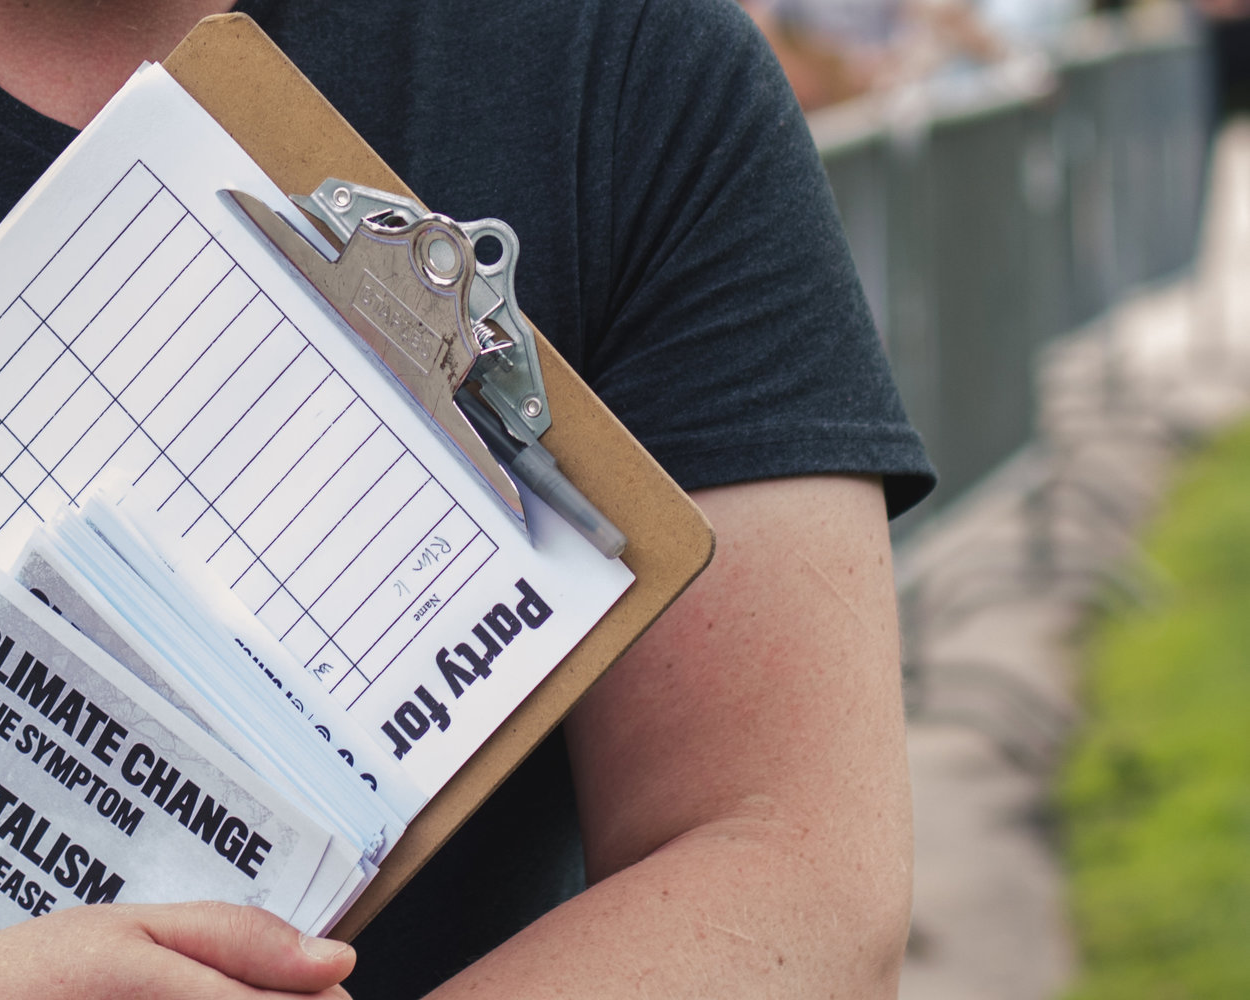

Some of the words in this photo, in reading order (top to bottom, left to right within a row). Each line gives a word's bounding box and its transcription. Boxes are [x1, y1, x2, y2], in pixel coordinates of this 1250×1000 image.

[360, 284, 431, 360] STAPLES
[412, 593, 442, 623] Name
[436, 577, 554, 698] Party
[381, 684, 451, 761] for
[14, 724, 145, 837] SYMPTOM
[120, 742, 273, 880] CHANGE
